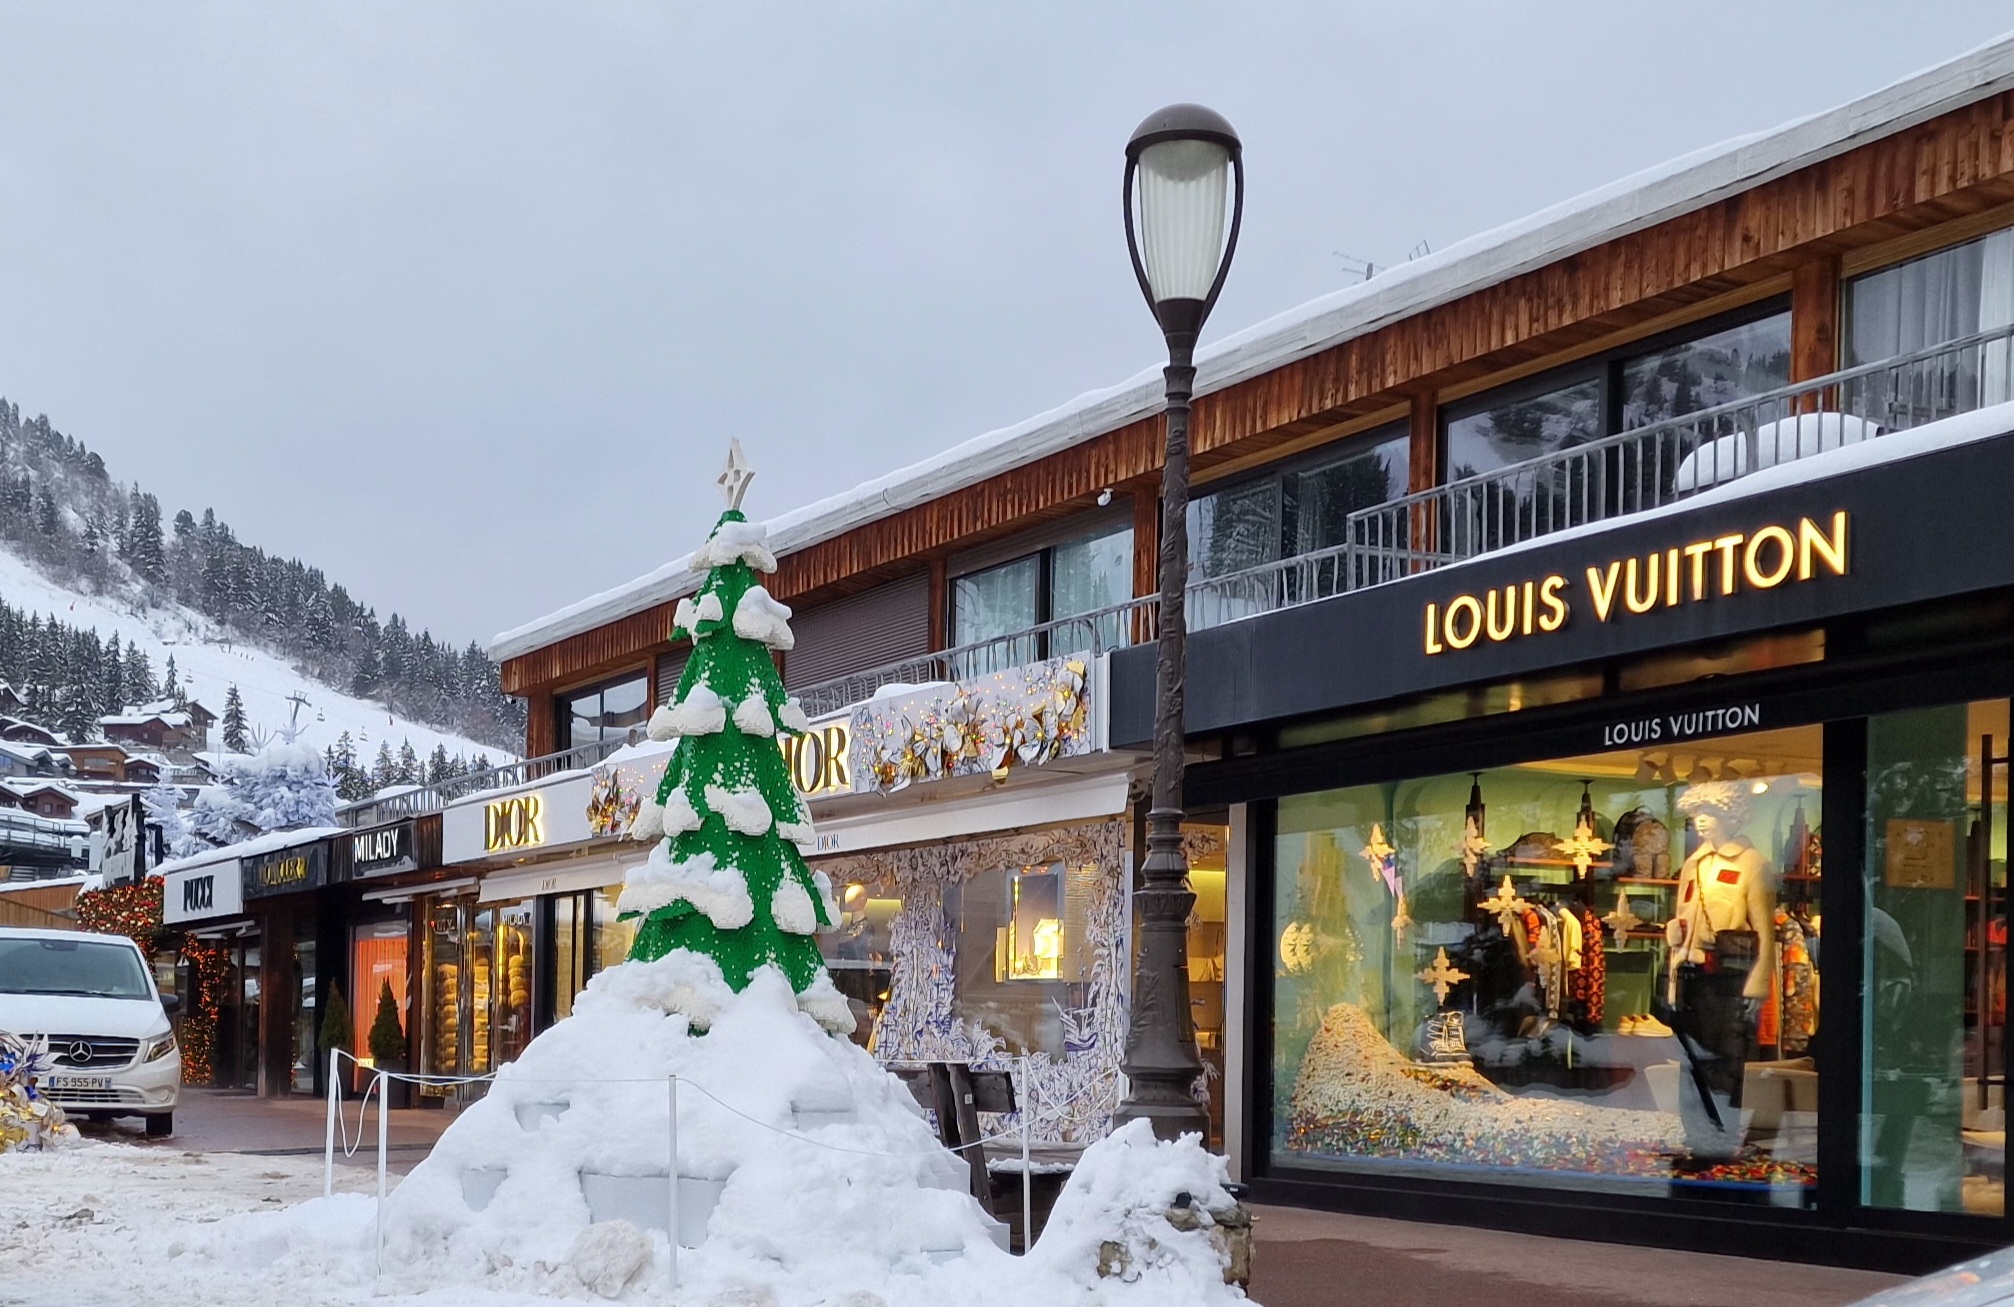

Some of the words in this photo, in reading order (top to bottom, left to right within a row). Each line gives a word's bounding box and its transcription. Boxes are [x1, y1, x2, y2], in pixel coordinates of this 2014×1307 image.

[1424, 575, 1570, 656] LOUIS
[1586, 509, 1851, 623] VUITTON
[1603, 718, 1662, 747] LOUIS
[1670, 703, 1760, 738] VUITTON
[784, 726, 849, 793] IOR
[483, 795, 543, 851] DIOR
[817, 834, 840, 851] DIOR
[354, 827, 399, 864] MILADY
[183, 875, 215, 912] PUCCI
